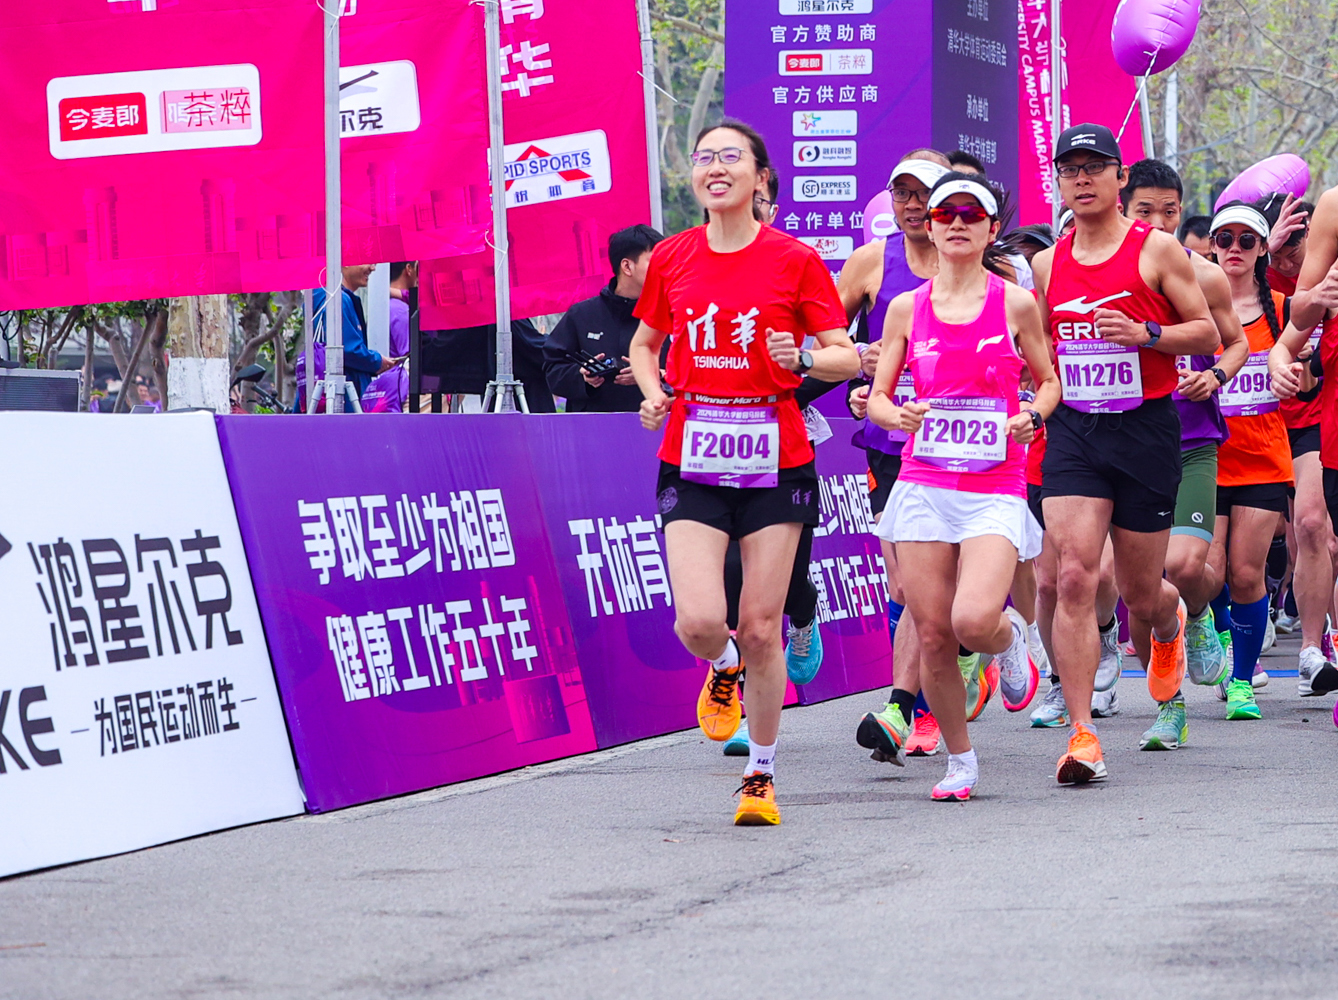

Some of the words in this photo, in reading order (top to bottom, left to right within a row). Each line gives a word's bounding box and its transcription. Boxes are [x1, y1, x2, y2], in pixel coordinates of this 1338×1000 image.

[797, 0, 854, 13] 鸿星尔克
[770, 23, 877, 43] 官方赞助商
[787, 57, 821, 69] 今麦郎
[772, 85, 879, 105] 官方供应商
[66, 104, 141, 130] 今麦郎
[184, 88, 252, 128] 茶粹
[1021, 54, 1041, 117] CAMPUS
[1031, 119, 1053, 205] MARATHON
[529, 151, 592, 175] SPORTS
[820, 181, 851, 189] EXPRESS
[783, 211, 864, 231] 合作单位
[1057, 321, 1104, 340] ER
[693, 356, 750, 370] TSINGHUA
[1064, 361, 1134, 387] M1276
[922, 417, 998, 445] F2023
[690, 431, 771, 460] F2004
[297, 488, 516, 586] 争取至少为祖国
[567, 513, 673, 618] 无体育
[27, 529, 244, 672] 鸿星尔克
[325, 595, 539, 703] 健康工作五十年
